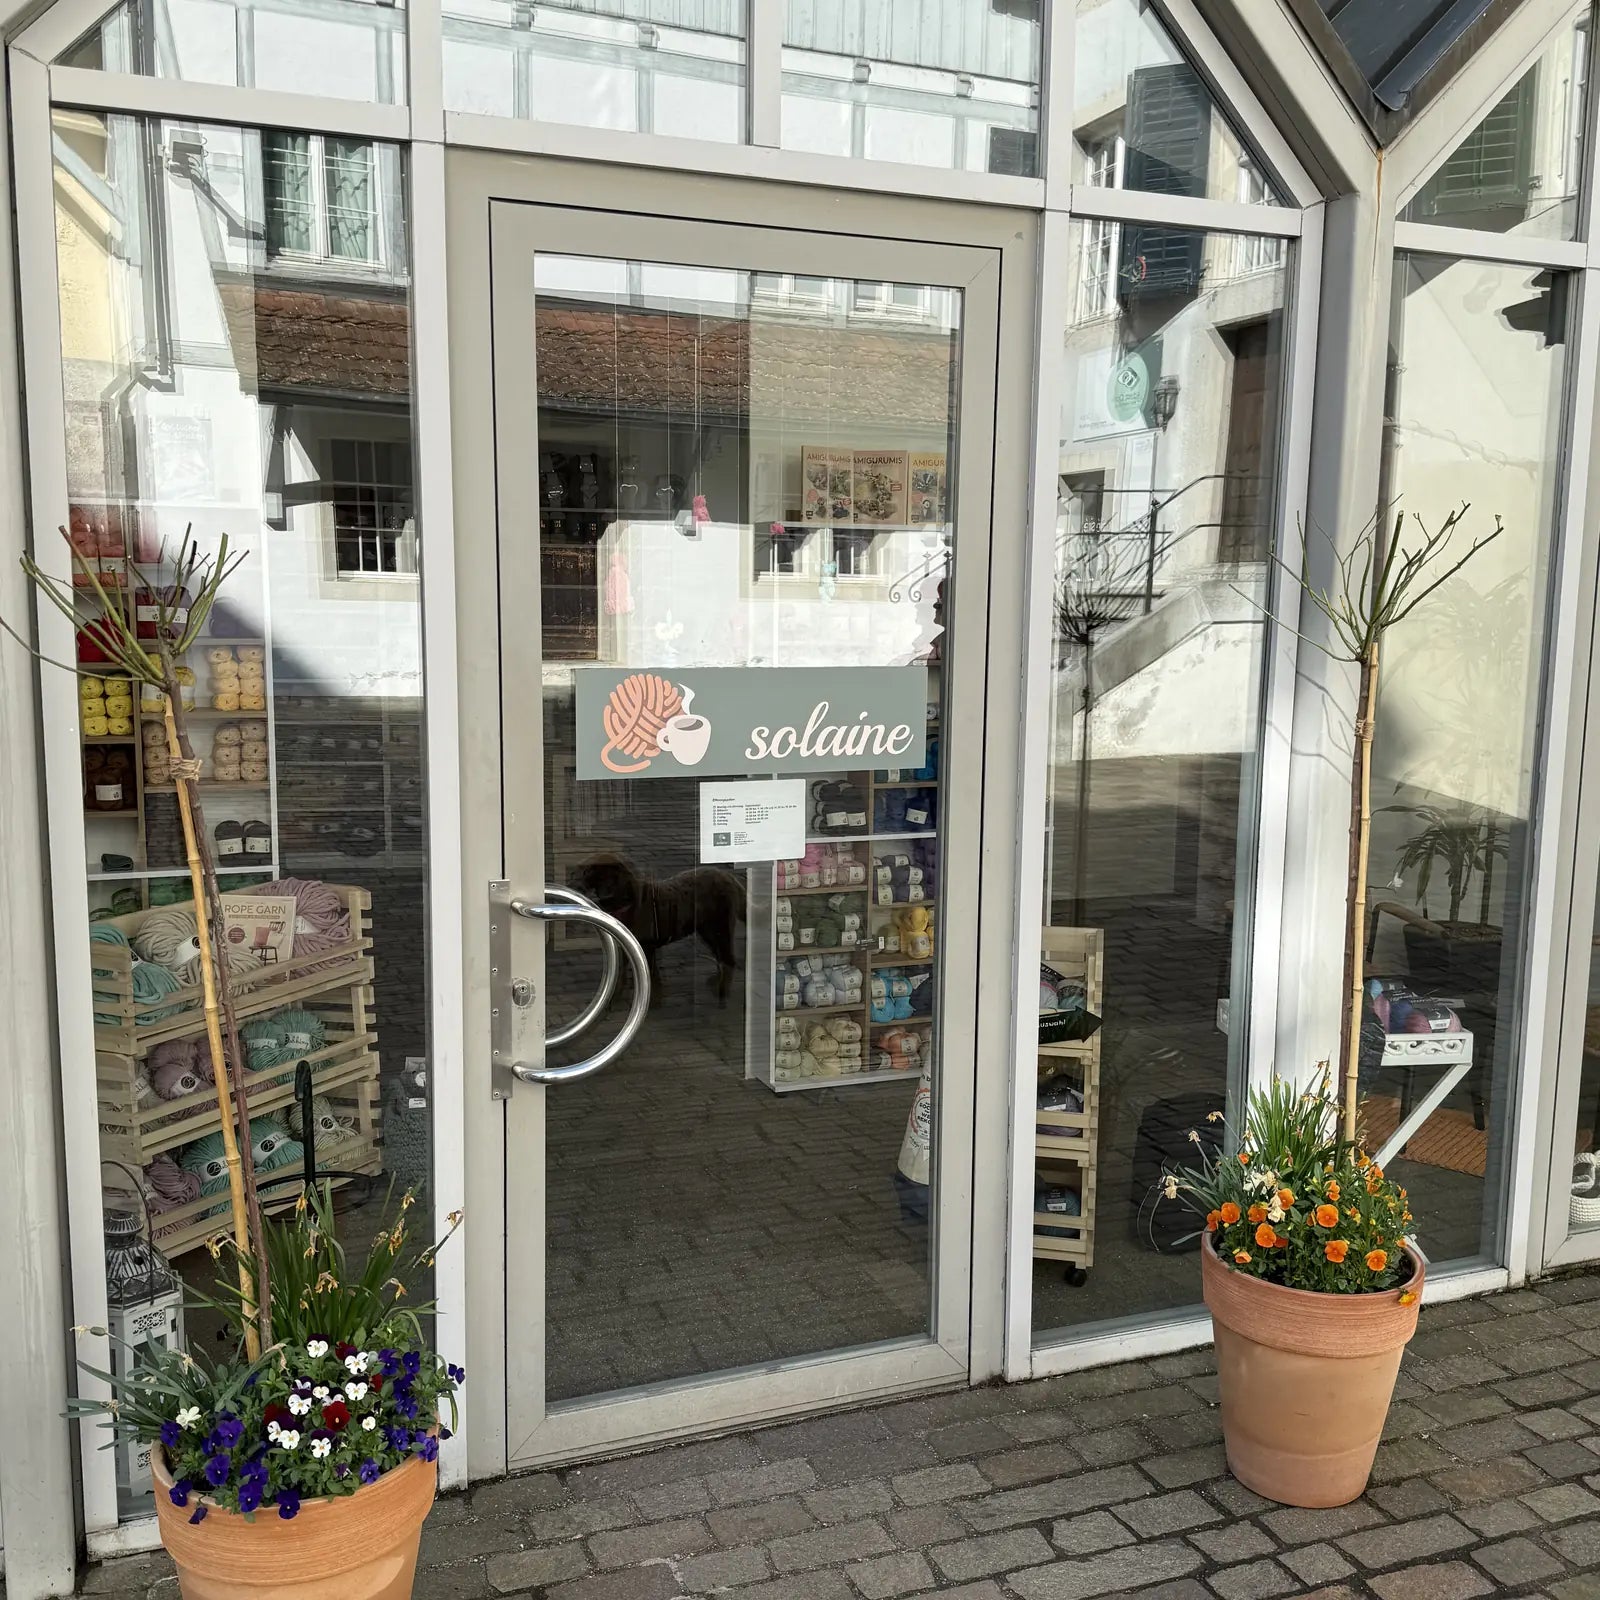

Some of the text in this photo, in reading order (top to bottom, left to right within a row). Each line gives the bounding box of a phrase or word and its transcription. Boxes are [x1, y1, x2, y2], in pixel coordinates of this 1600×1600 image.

[807, 453, 851, 464] AMIGRUMIS
[854, 456, 903, 465] AMIGURUMIS
[745, 701, 914, 760] solaine
[224, 904, 286, 915] ROPE GARN
[1040, 1018, 1066, 1028] uswahl
